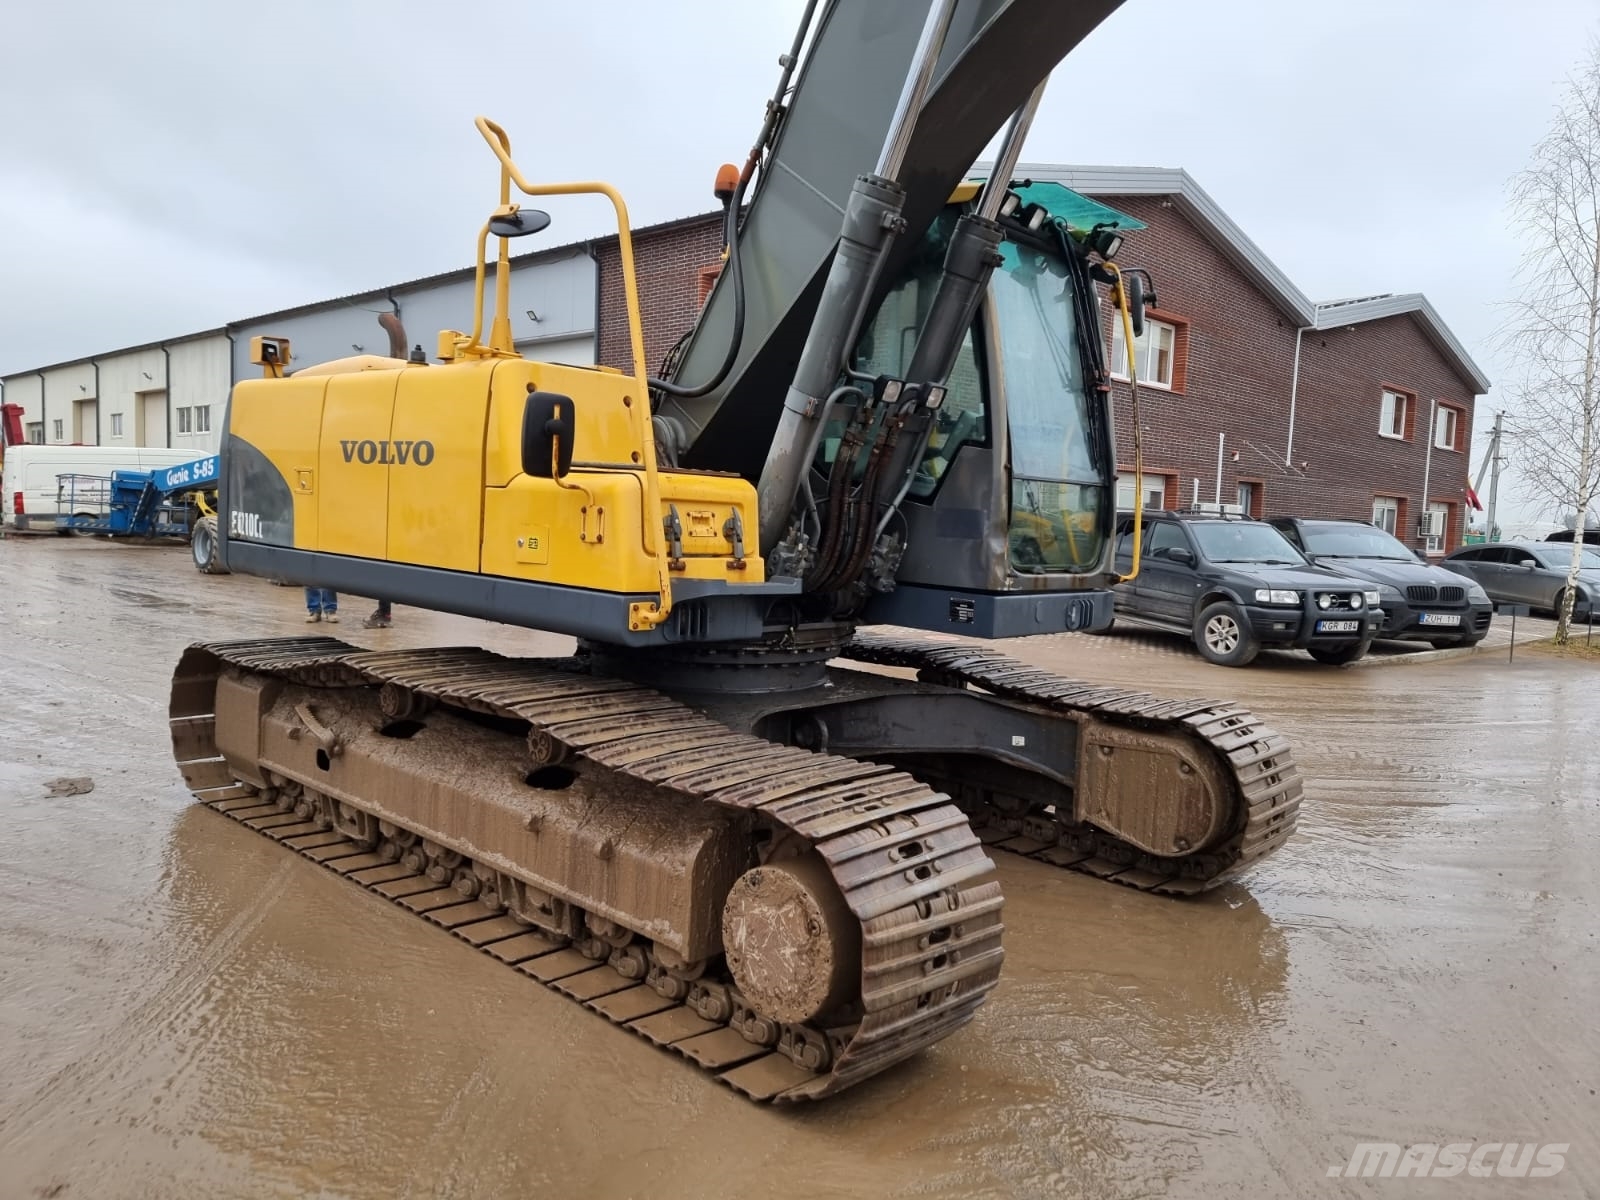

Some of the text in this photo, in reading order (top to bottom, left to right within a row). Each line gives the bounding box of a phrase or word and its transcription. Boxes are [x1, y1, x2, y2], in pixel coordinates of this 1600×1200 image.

[340, 440, 435, 466] VOLVO
[167, 459, 214, 486] Genie S-85
[1322, 621, 1339, 630] KGR
